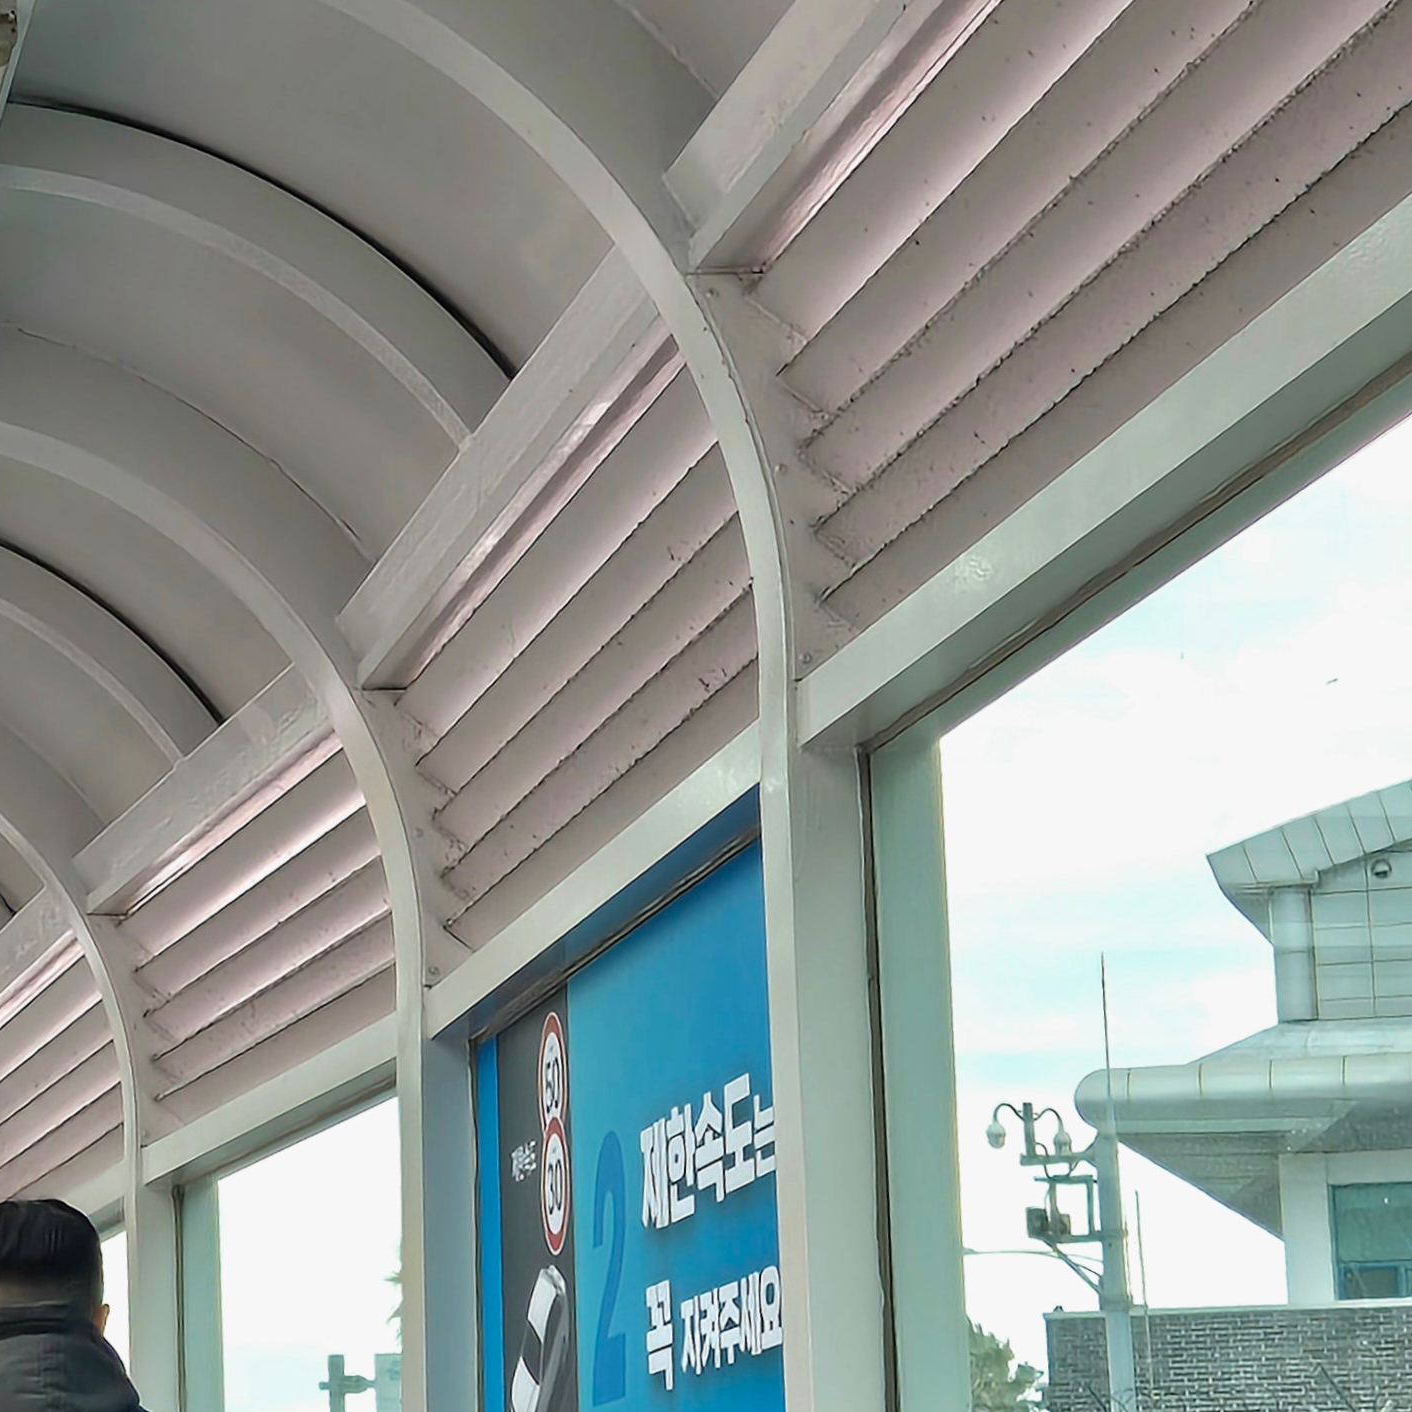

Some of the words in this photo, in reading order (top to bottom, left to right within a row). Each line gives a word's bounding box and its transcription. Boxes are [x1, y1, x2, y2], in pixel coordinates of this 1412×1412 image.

[547, 1158, 563, 1216] 30
[638, 1073, 776, 1230] 제한속도는
[592, 1131, 627, 1407] 2
[645, 1279, 674, 1391] 꼭
[680, 1265, 784, 1376] 지켜주세요
